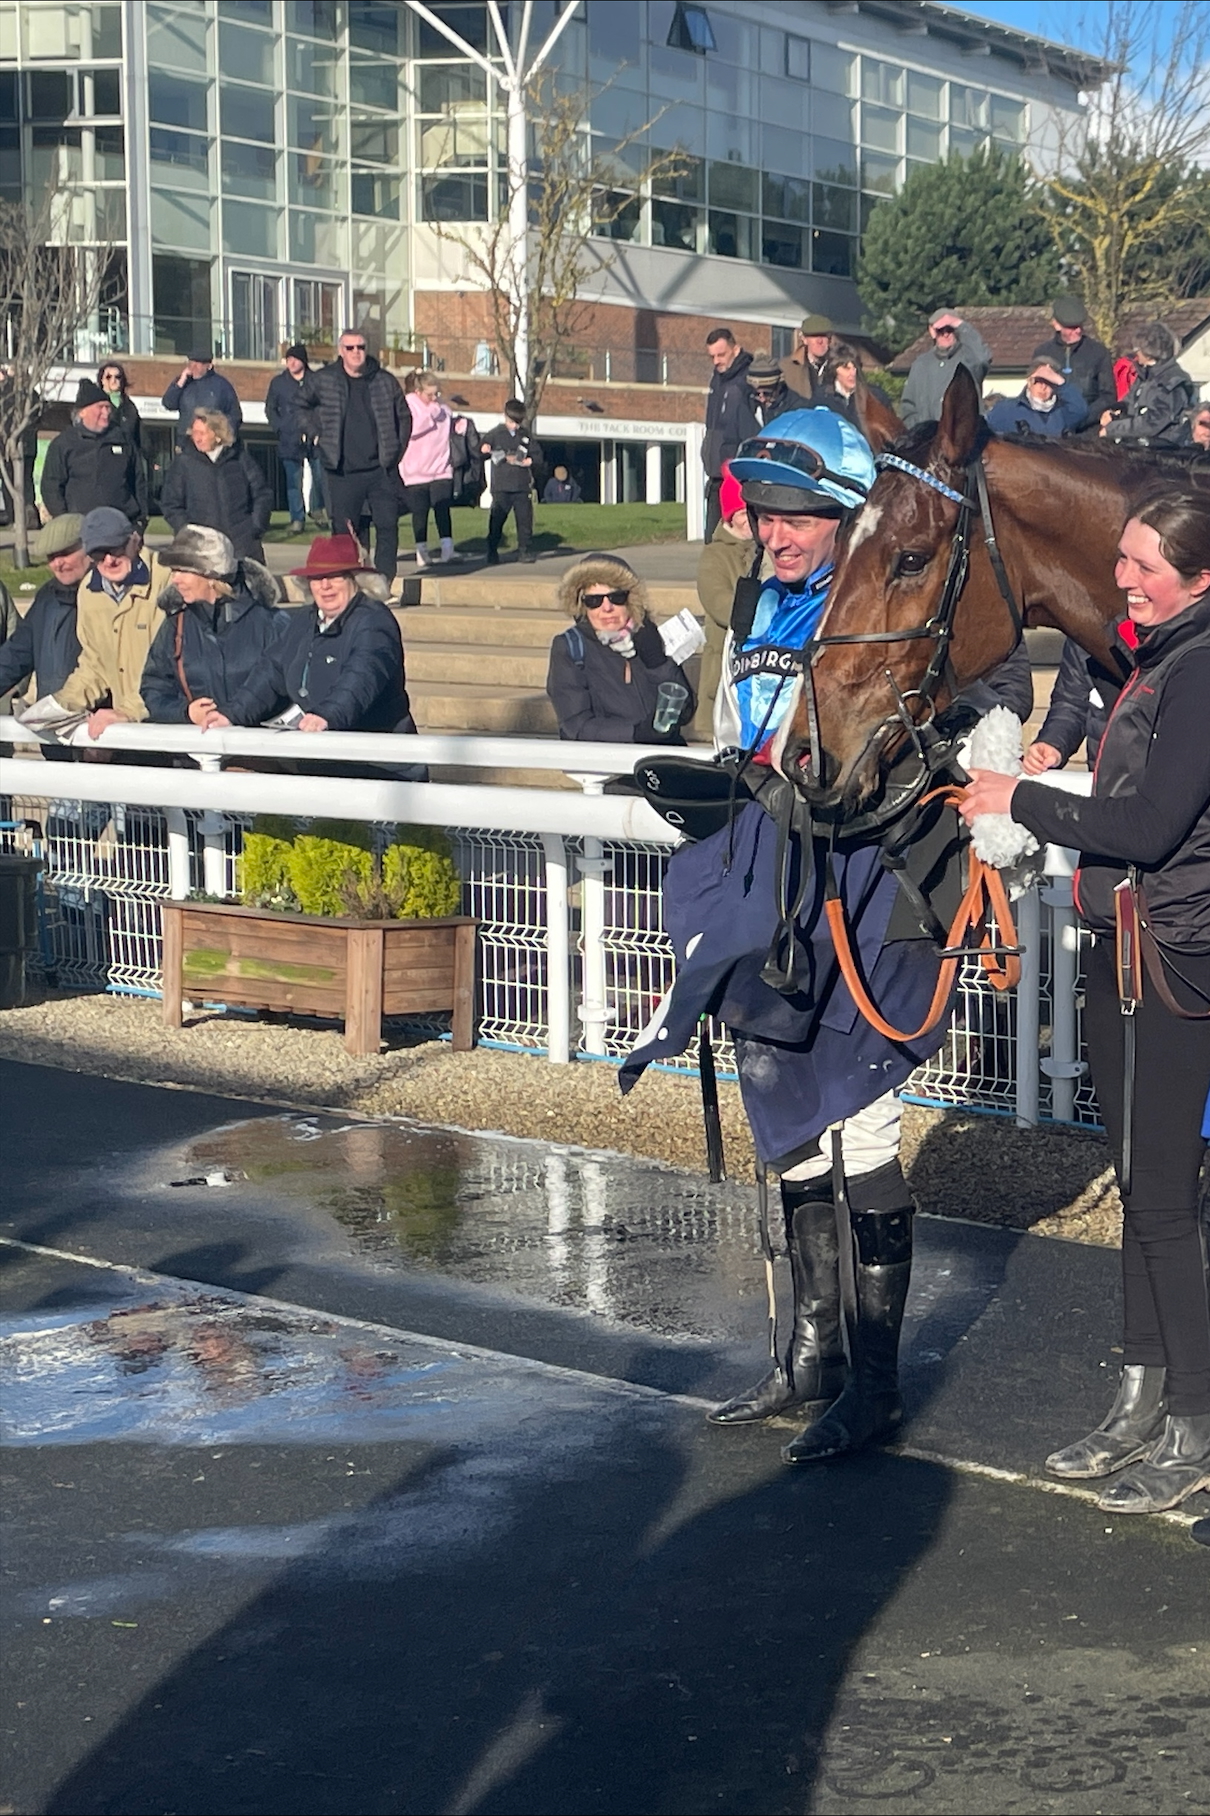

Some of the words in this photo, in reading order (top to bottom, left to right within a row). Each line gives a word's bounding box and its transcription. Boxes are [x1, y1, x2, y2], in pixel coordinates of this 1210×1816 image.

[580, 422, 600, 433] THE
[603, 423, 630, 434] TACK
[633, 425, 664, 435] ROOM
